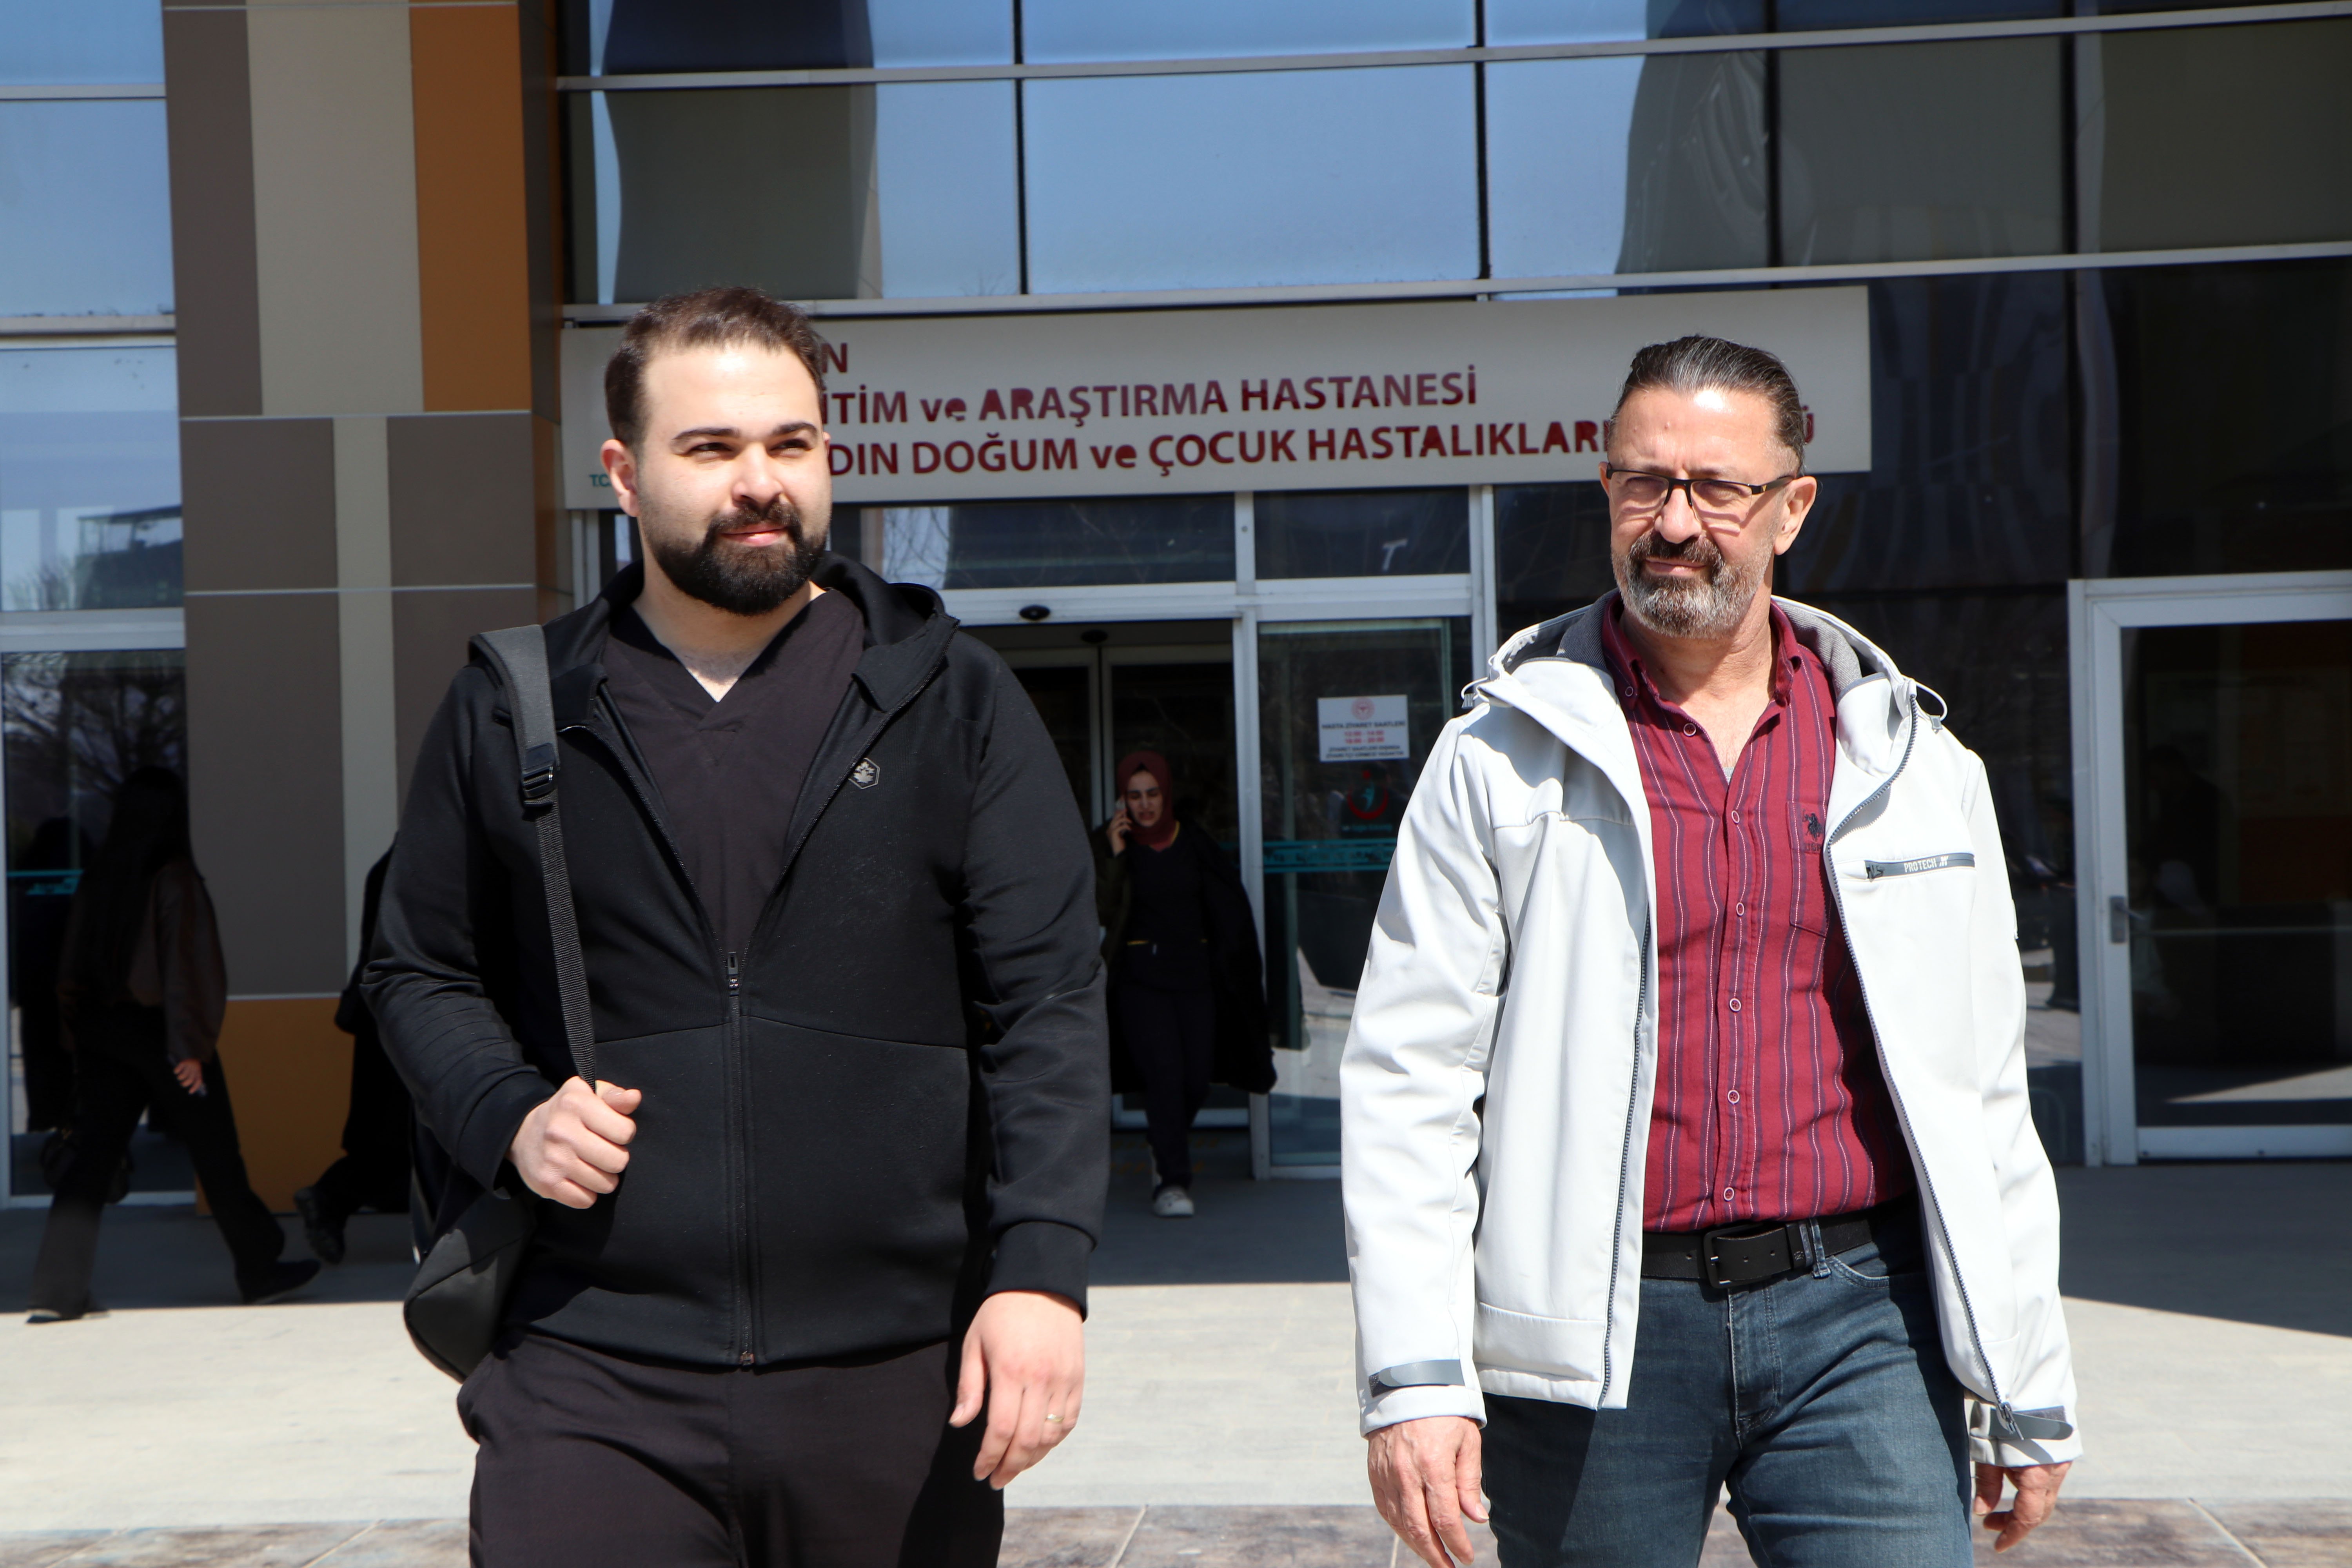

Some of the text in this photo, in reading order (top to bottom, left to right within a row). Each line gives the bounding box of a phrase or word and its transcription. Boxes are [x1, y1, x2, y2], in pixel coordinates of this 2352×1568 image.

[822, 365, 1476, 427] İTİM ve ARAŞTIRMA HASTANESİ
[828, 443, 898, 476] DIN
[912, 432, 1078, 474] DOĞUM
[1090, 445, 1138, 469] ve
[1149, 430, 1297, 477] ÇOCUK
[1904, 858, 1937, 873] PROTECH
